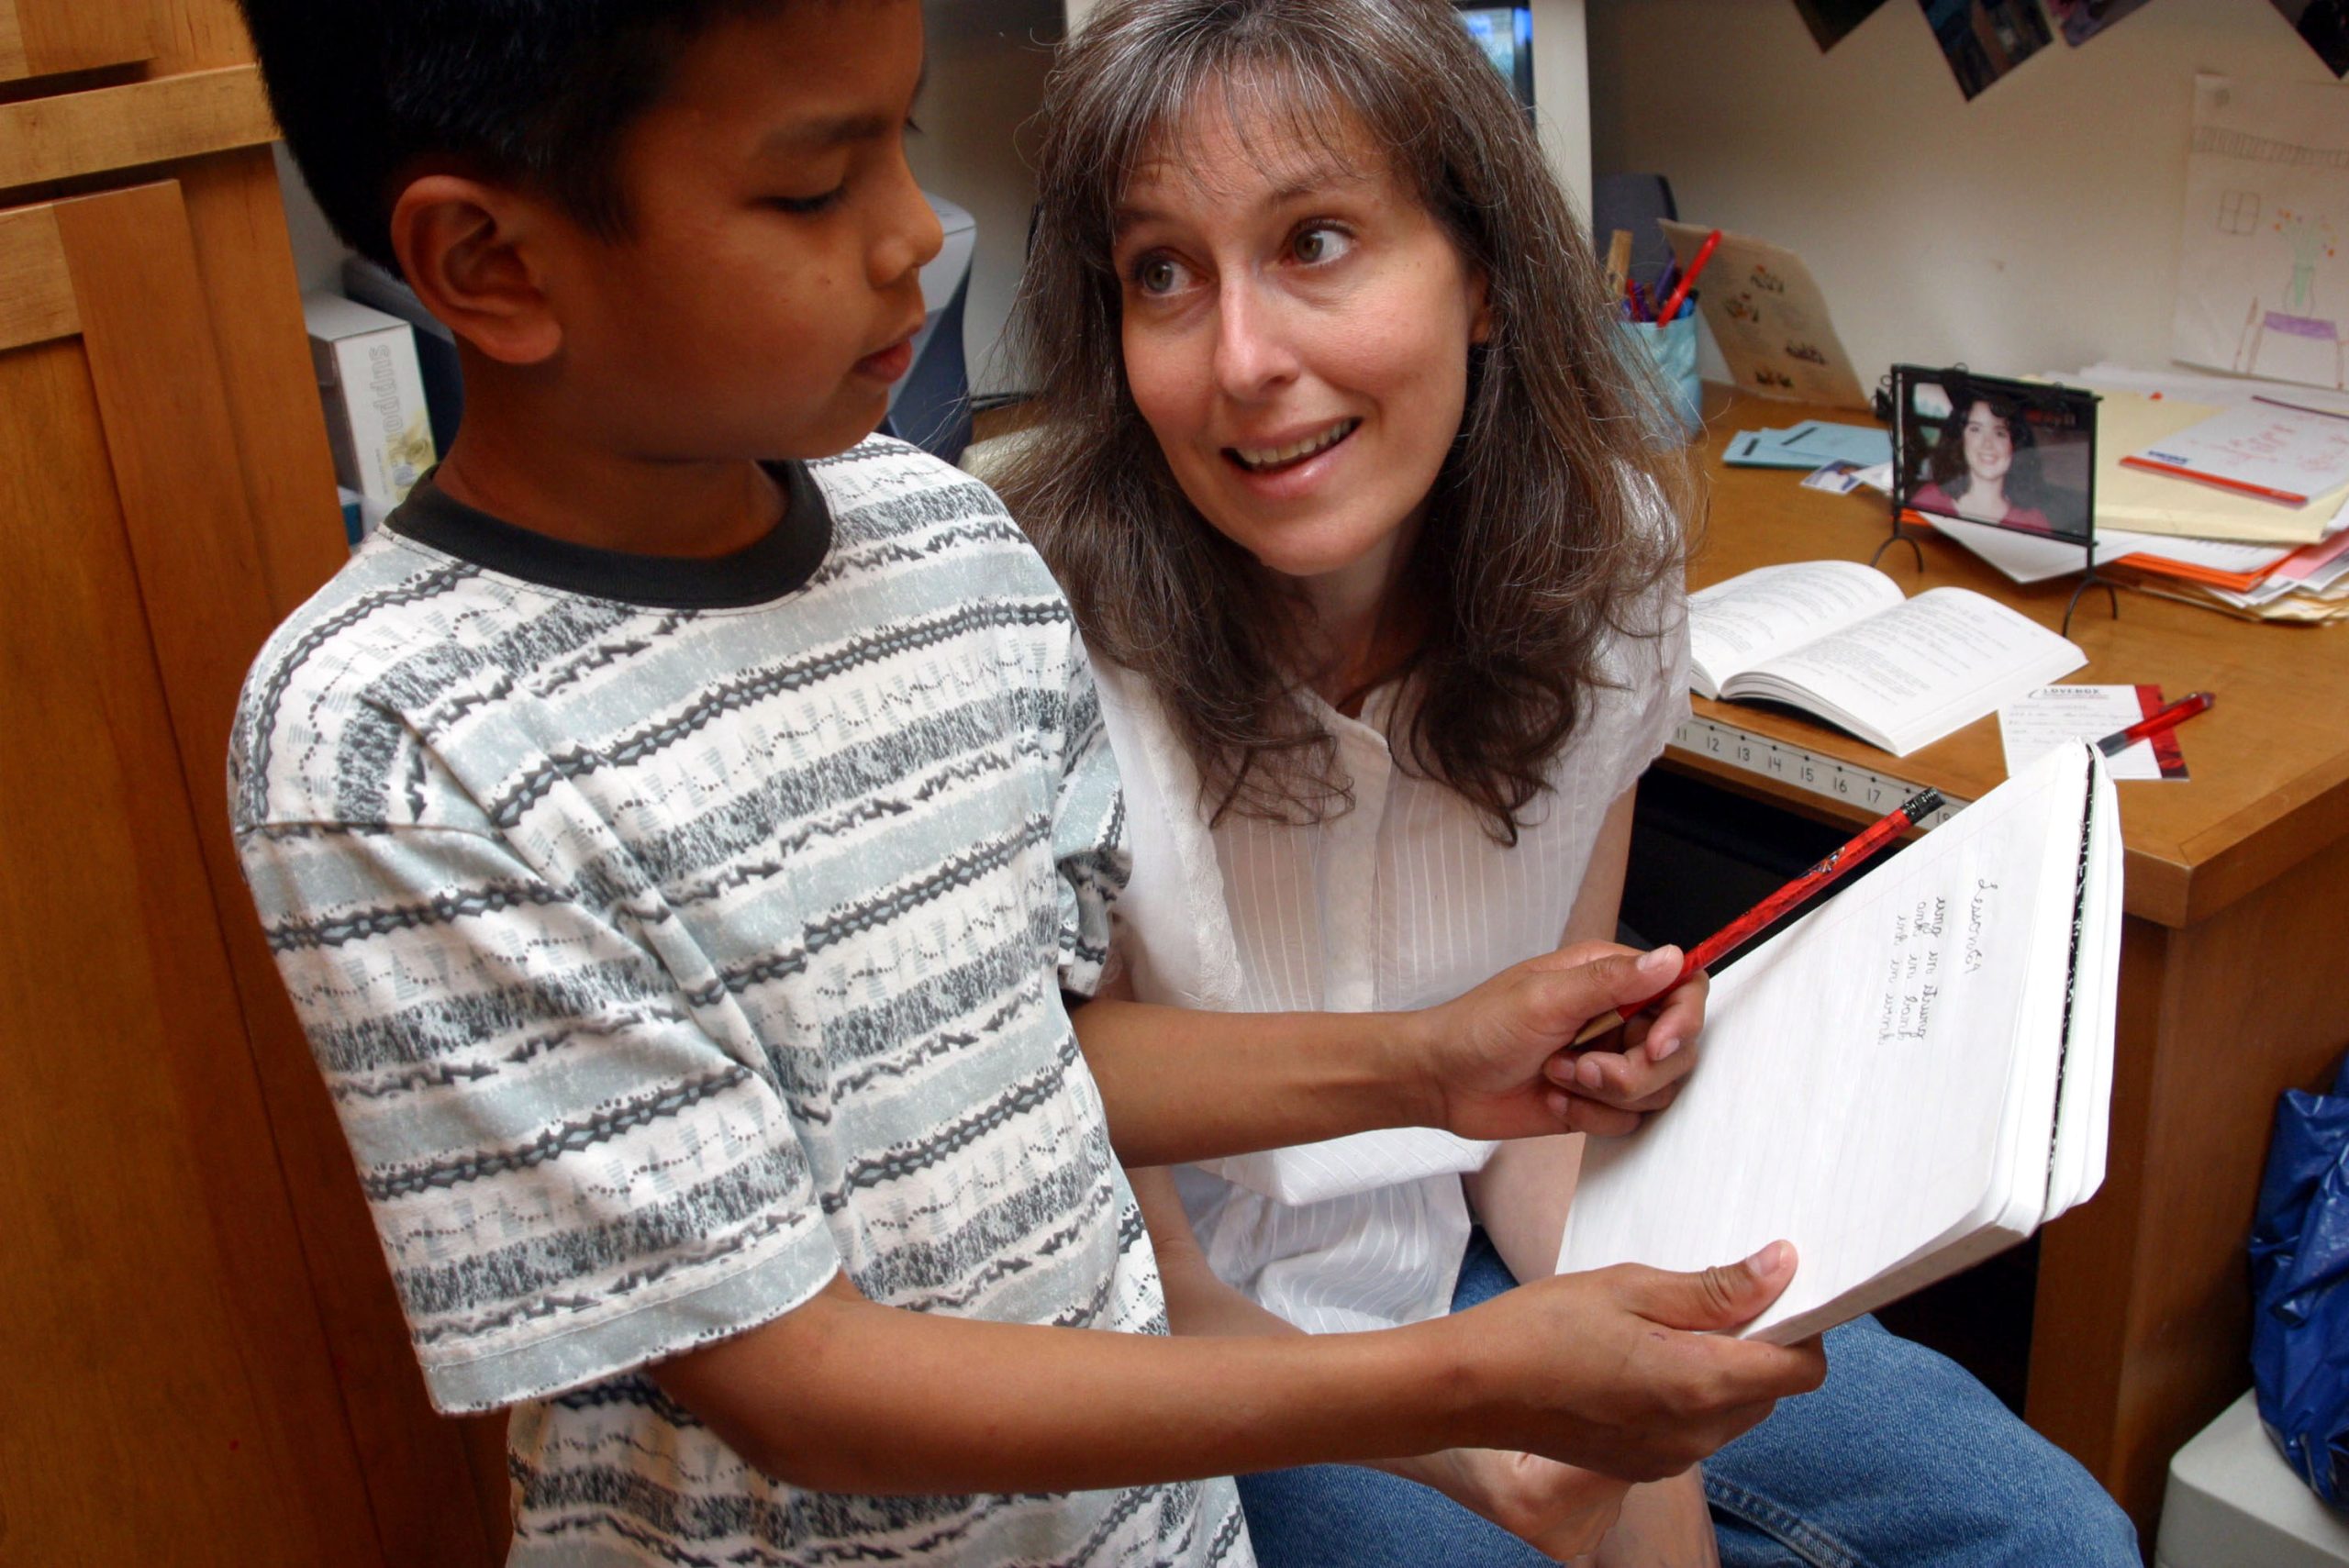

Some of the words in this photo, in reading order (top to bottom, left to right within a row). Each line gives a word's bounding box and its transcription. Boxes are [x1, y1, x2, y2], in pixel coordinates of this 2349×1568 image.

[1676, 727, 1687, 741] 11
[1707, 736, 1720, 752] 12
[1737, 746, 1751, 762] 13
[1767, 756, 1781, 772] 14
[1799, 767, 1814, 783] 15
[1833, 777, 1848, 793] 16
[1866, 788, 1881, 804] 17
